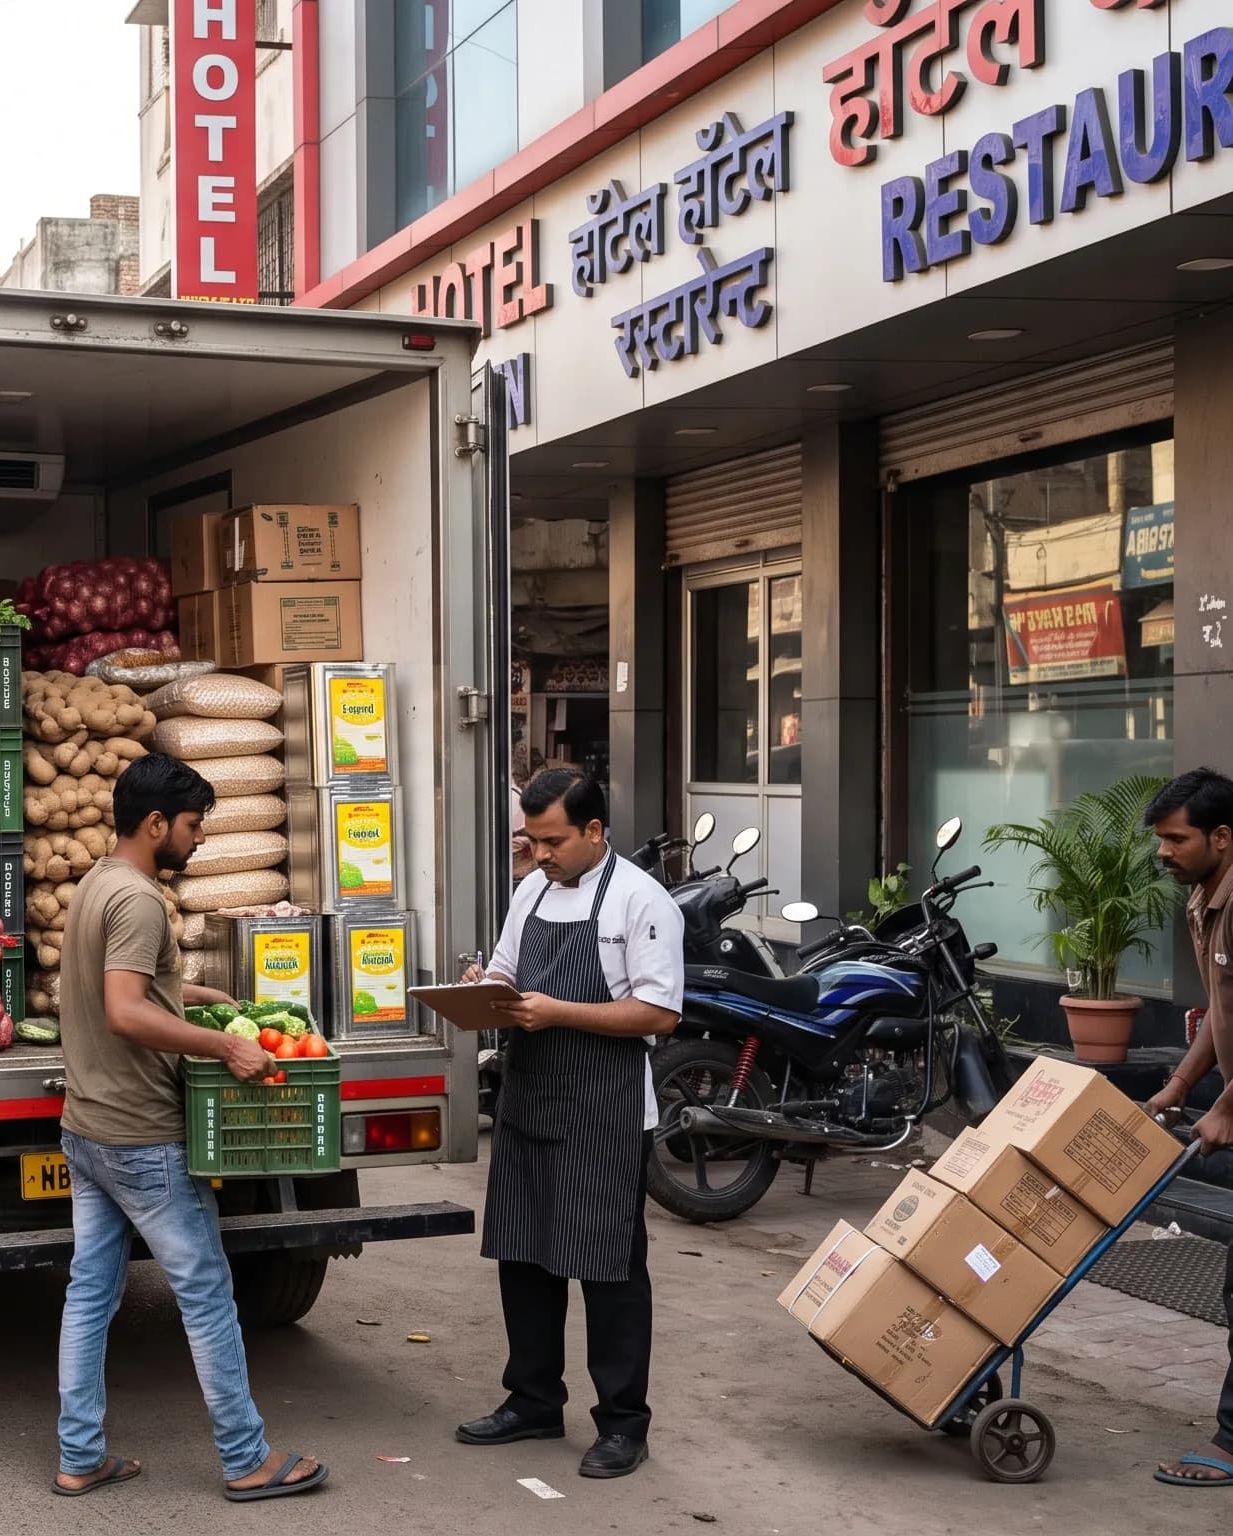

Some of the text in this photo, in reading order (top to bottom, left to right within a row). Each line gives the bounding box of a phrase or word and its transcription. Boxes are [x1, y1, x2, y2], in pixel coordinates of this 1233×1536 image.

[192, 0, 239, 284] HOTEL
[569, 111, 795, 298] हॉटेल हॉटेल
